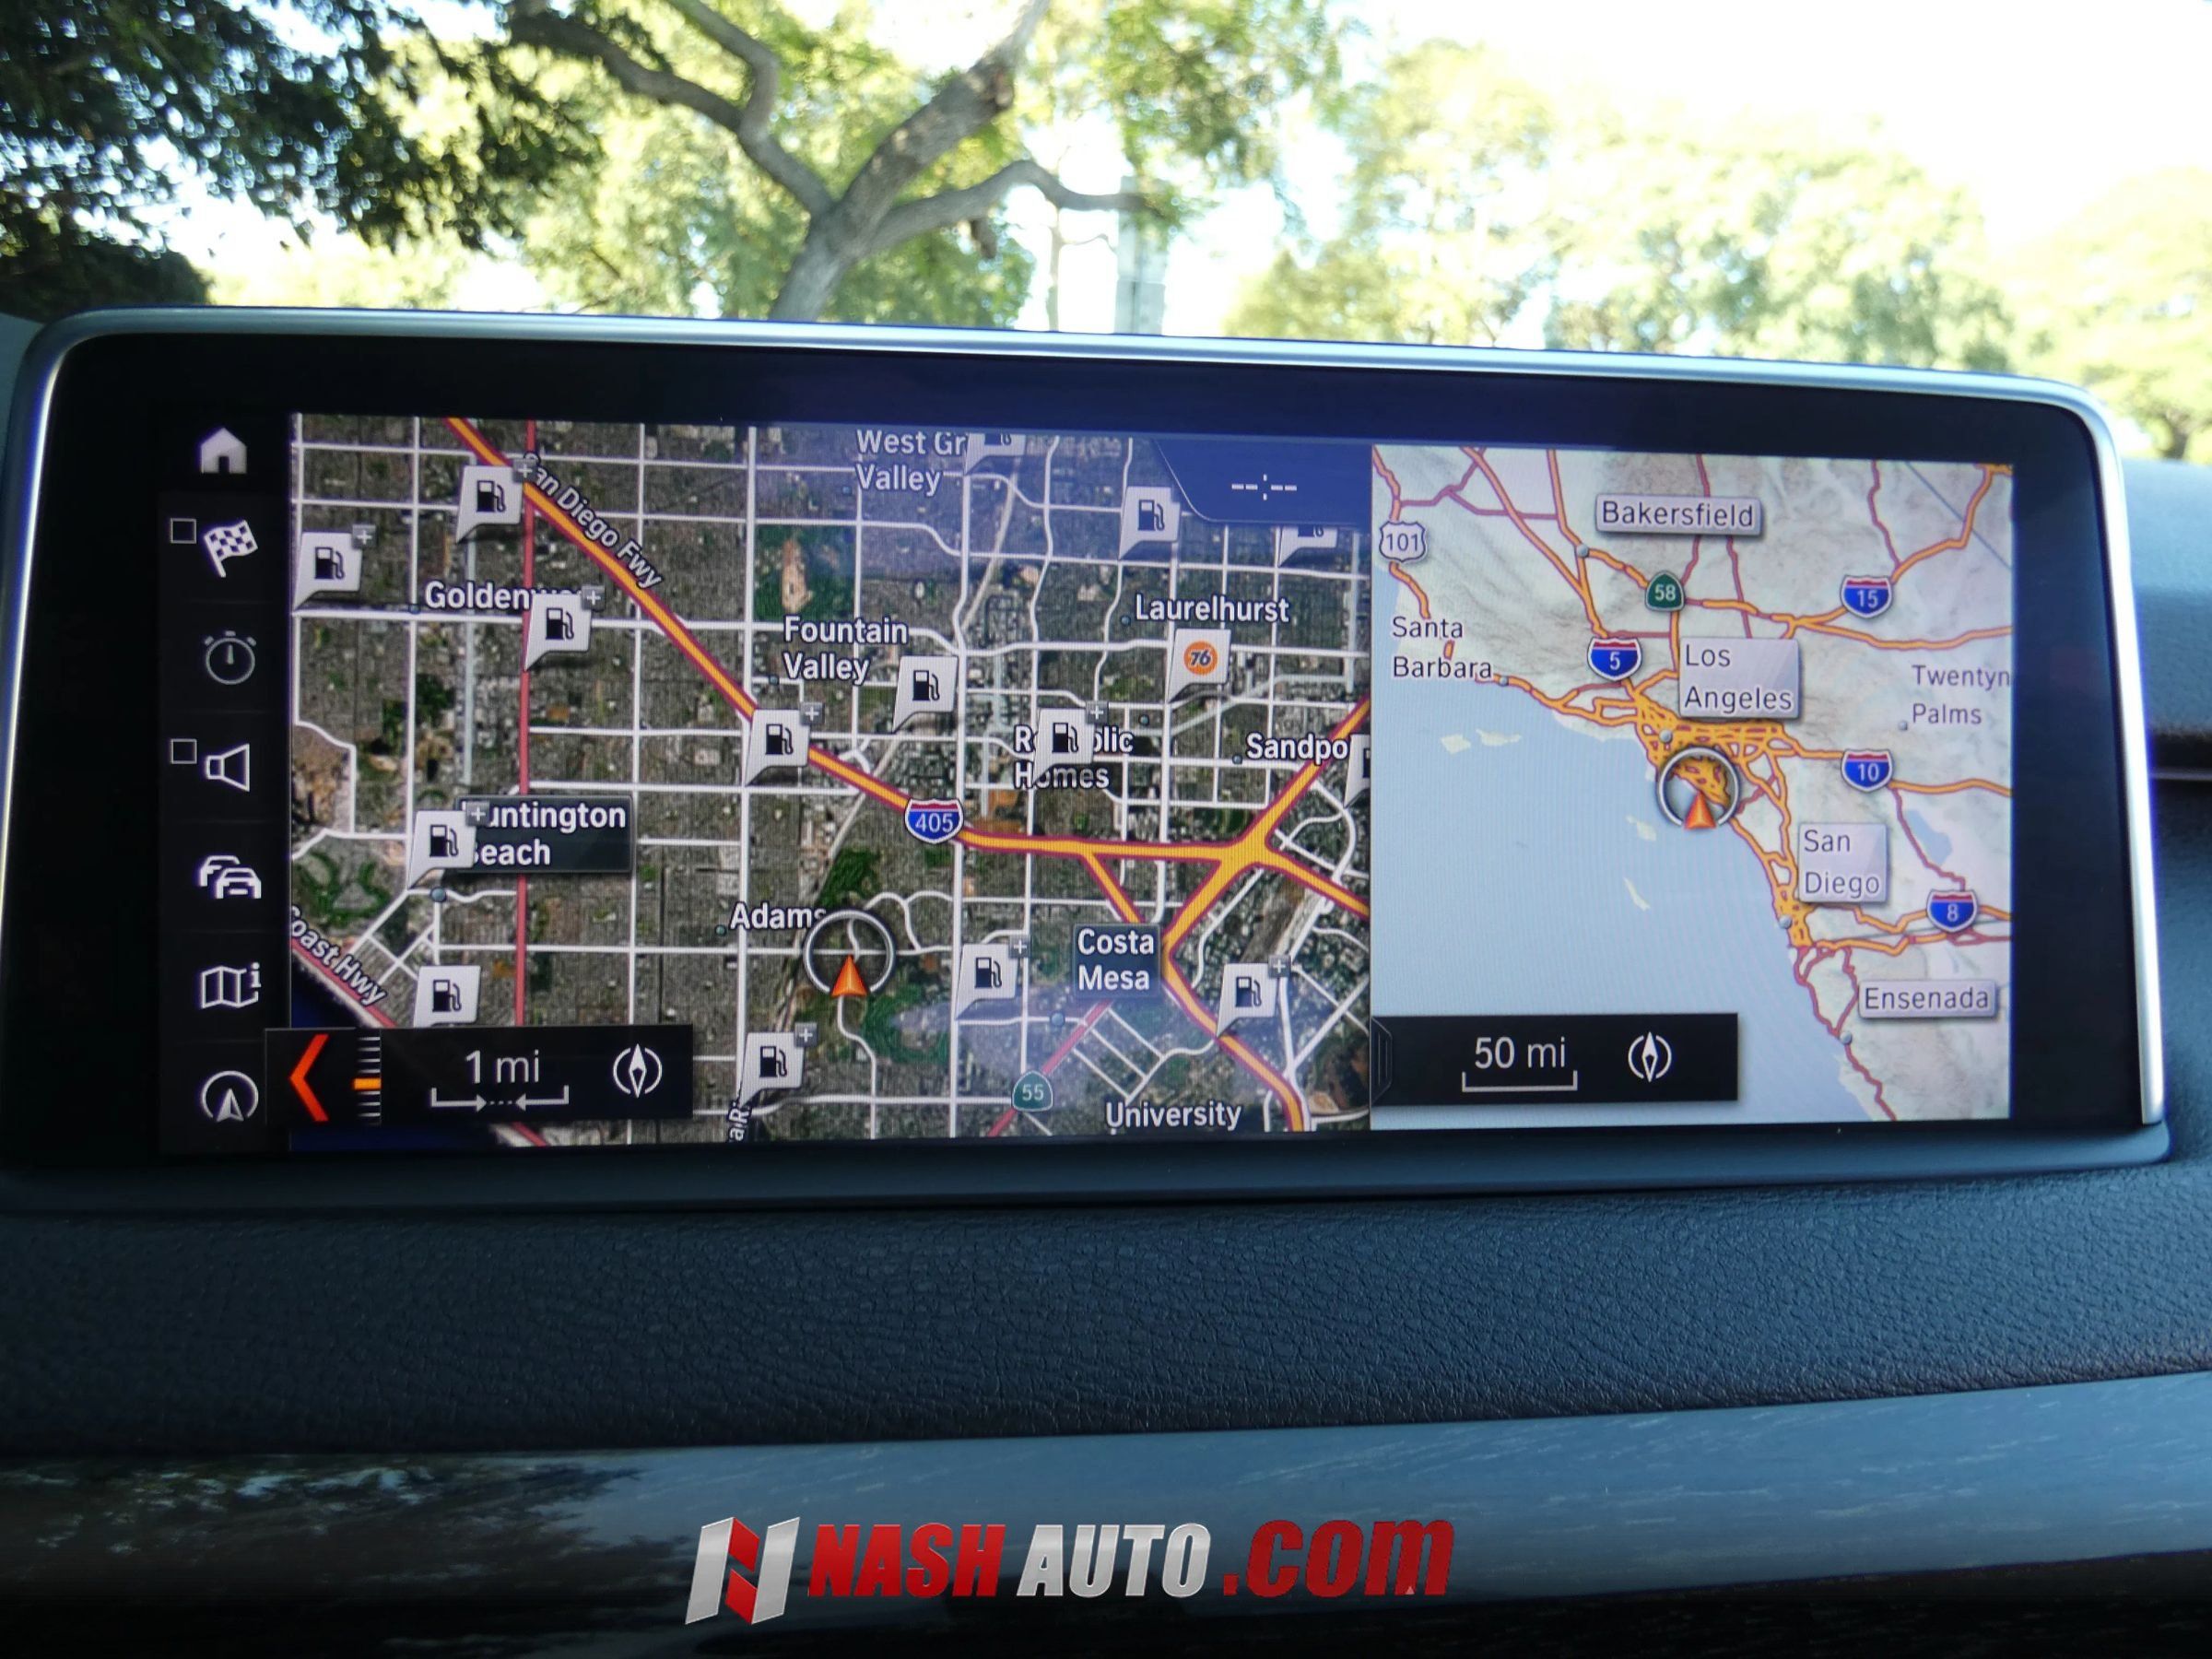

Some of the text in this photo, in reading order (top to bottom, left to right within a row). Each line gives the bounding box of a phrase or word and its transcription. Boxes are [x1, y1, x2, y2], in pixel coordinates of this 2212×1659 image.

[856, 429, 926, 454] West
[855, 464, 940, 497] Valley
[1601, 500, 1754, 527] Bakersfield
[557, 487, 619, 547] Diego
[617, 539, 663, 589] Fwy
[1384, 532, 1420, 553] 101
[425, 580, 582, 609] Golden
[1654, 583, 1677, 602] 58
[1856, 588, 1878, 608] 15
[1135, 593, 1290, 623] Laurelhurst
[784, 615, 909, 643] Fountain
[1392, 617, 1464, 640] Santa
[783, 652, 870, 686] Valley
[1190, 649, 1212, 666] 76
[1393, 656, 1493, 680] Barbara
[1608, 651, 1621, 670] 5
[1685, 645, 1732, 669] Los
[1911, 665, 2010, 691] Twentyn
[1684, 688, 1793, 714] Angeles
[1912, 702, 1983, 724] Palms
[1246, 732, 1348, 766] Sandpo
[1857, 762, 1880, 782] 10
[461, 800, 627, 834] untington
[914, 812, 955, 833] 405
[474, 839, 551, 865] each
[1804, 830, 1852, 853] San
[1804, 872, 1881, 900] Diego
[1947, 903, 1959, 922] 8
[1077, 928, 1155, 956] Costa
[334, 955, 387, 1006] Hwy
[1077, 965, 1151, 992] Mesa
[1865, 987, 1989, 1012] Ensenada
[1474, 1036, 1567, 1069] 50 mi
[465, 1048, 540, 1084] 1 mi
[1021, 1082, 1045, 1102] 55
[1106, 1101, 1241, 1130] University
